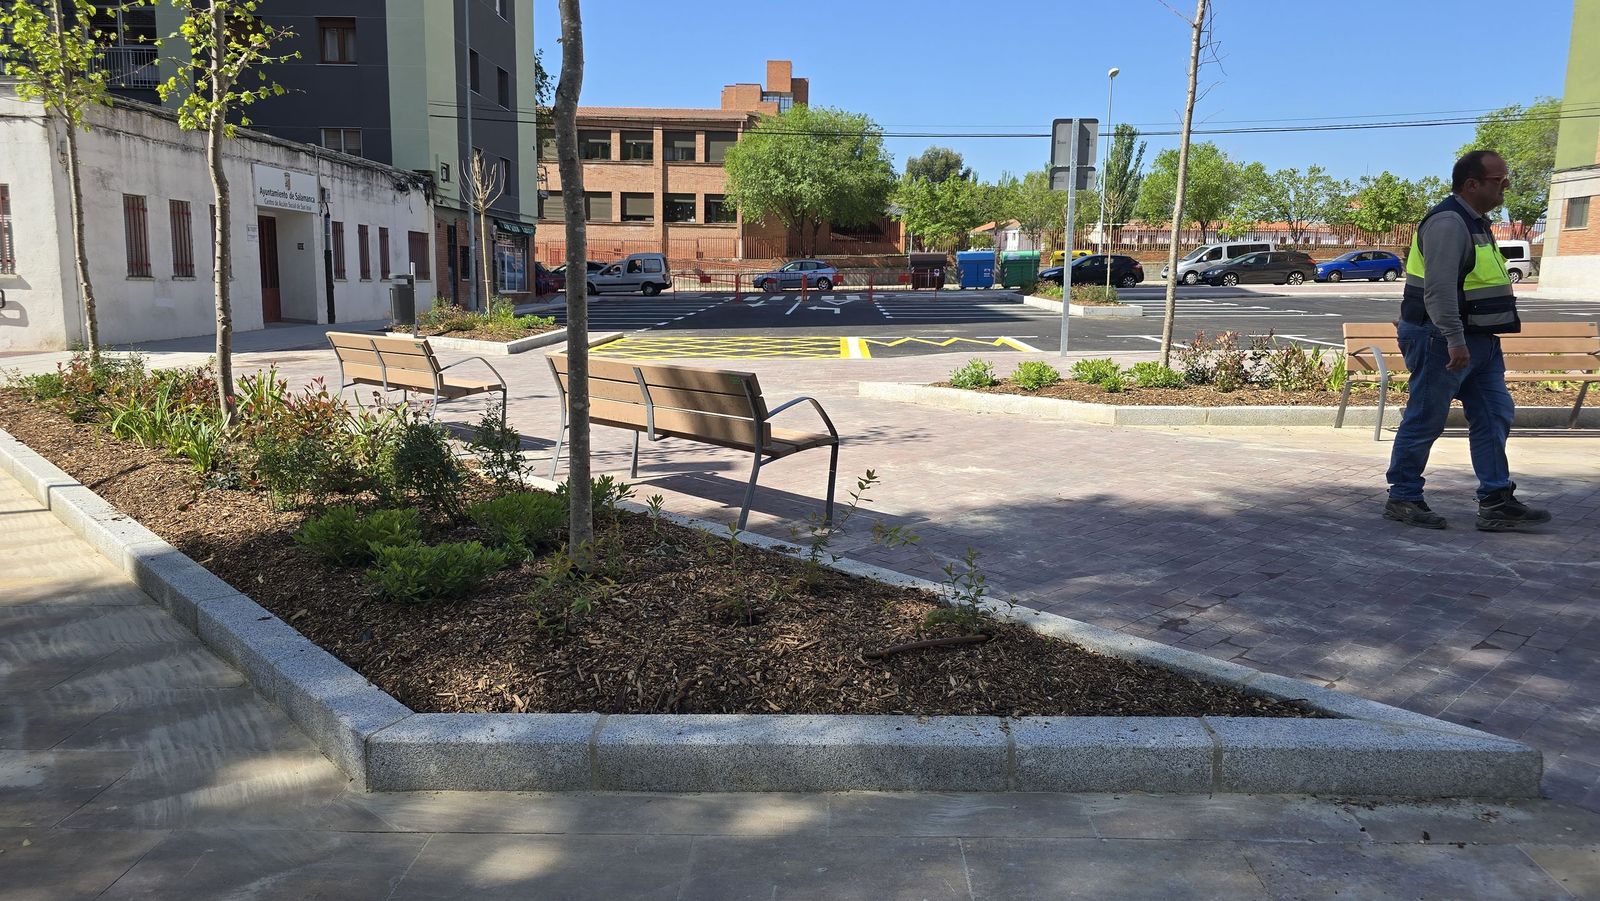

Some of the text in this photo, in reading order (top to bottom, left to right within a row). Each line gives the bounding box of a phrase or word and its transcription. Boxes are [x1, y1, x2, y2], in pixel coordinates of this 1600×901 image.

[259, 187, 315, 203] Ayuntamiento de Salamanca
